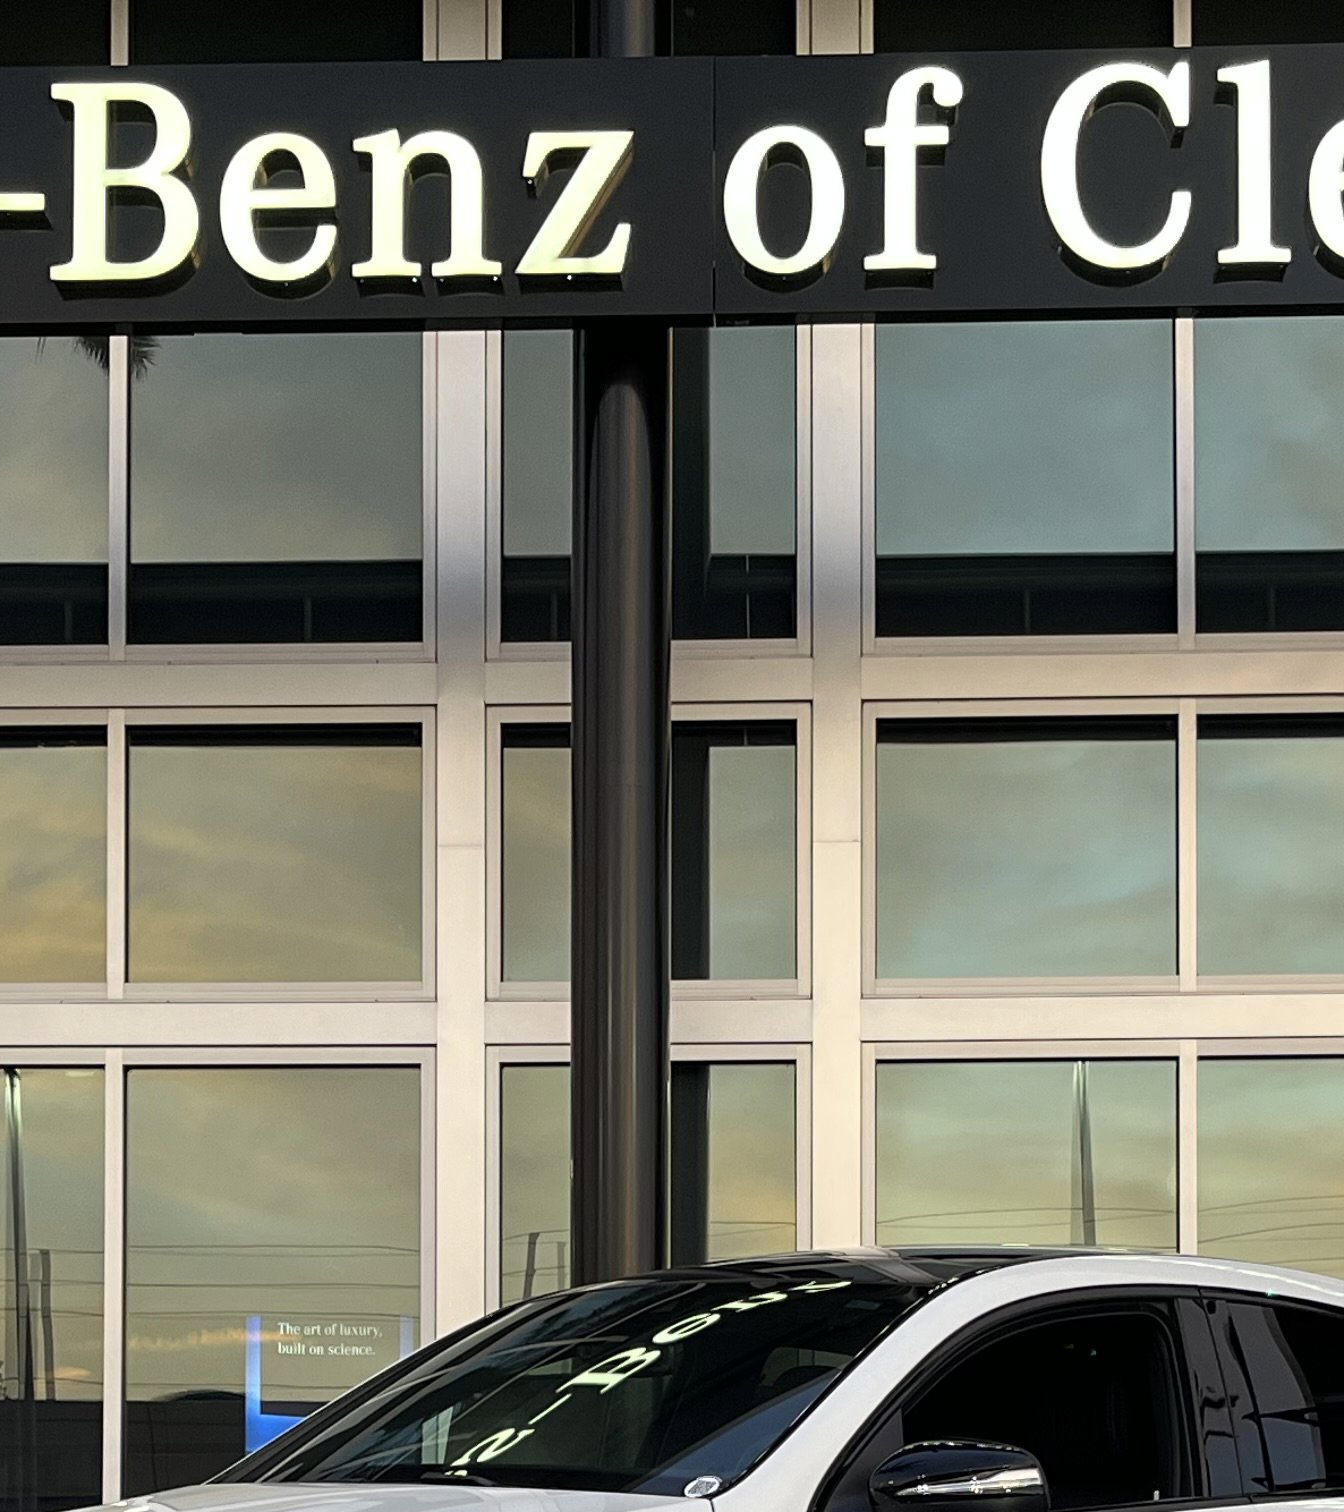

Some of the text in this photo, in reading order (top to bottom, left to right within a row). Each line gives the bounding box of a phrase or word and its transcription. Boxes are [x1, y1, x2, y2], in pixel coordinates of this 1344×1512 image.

[723, 66, 965, 275] of
[277, 1322, 383, 1339] The art of luxury,
[277, 1342, 376, 1356] built on science.
